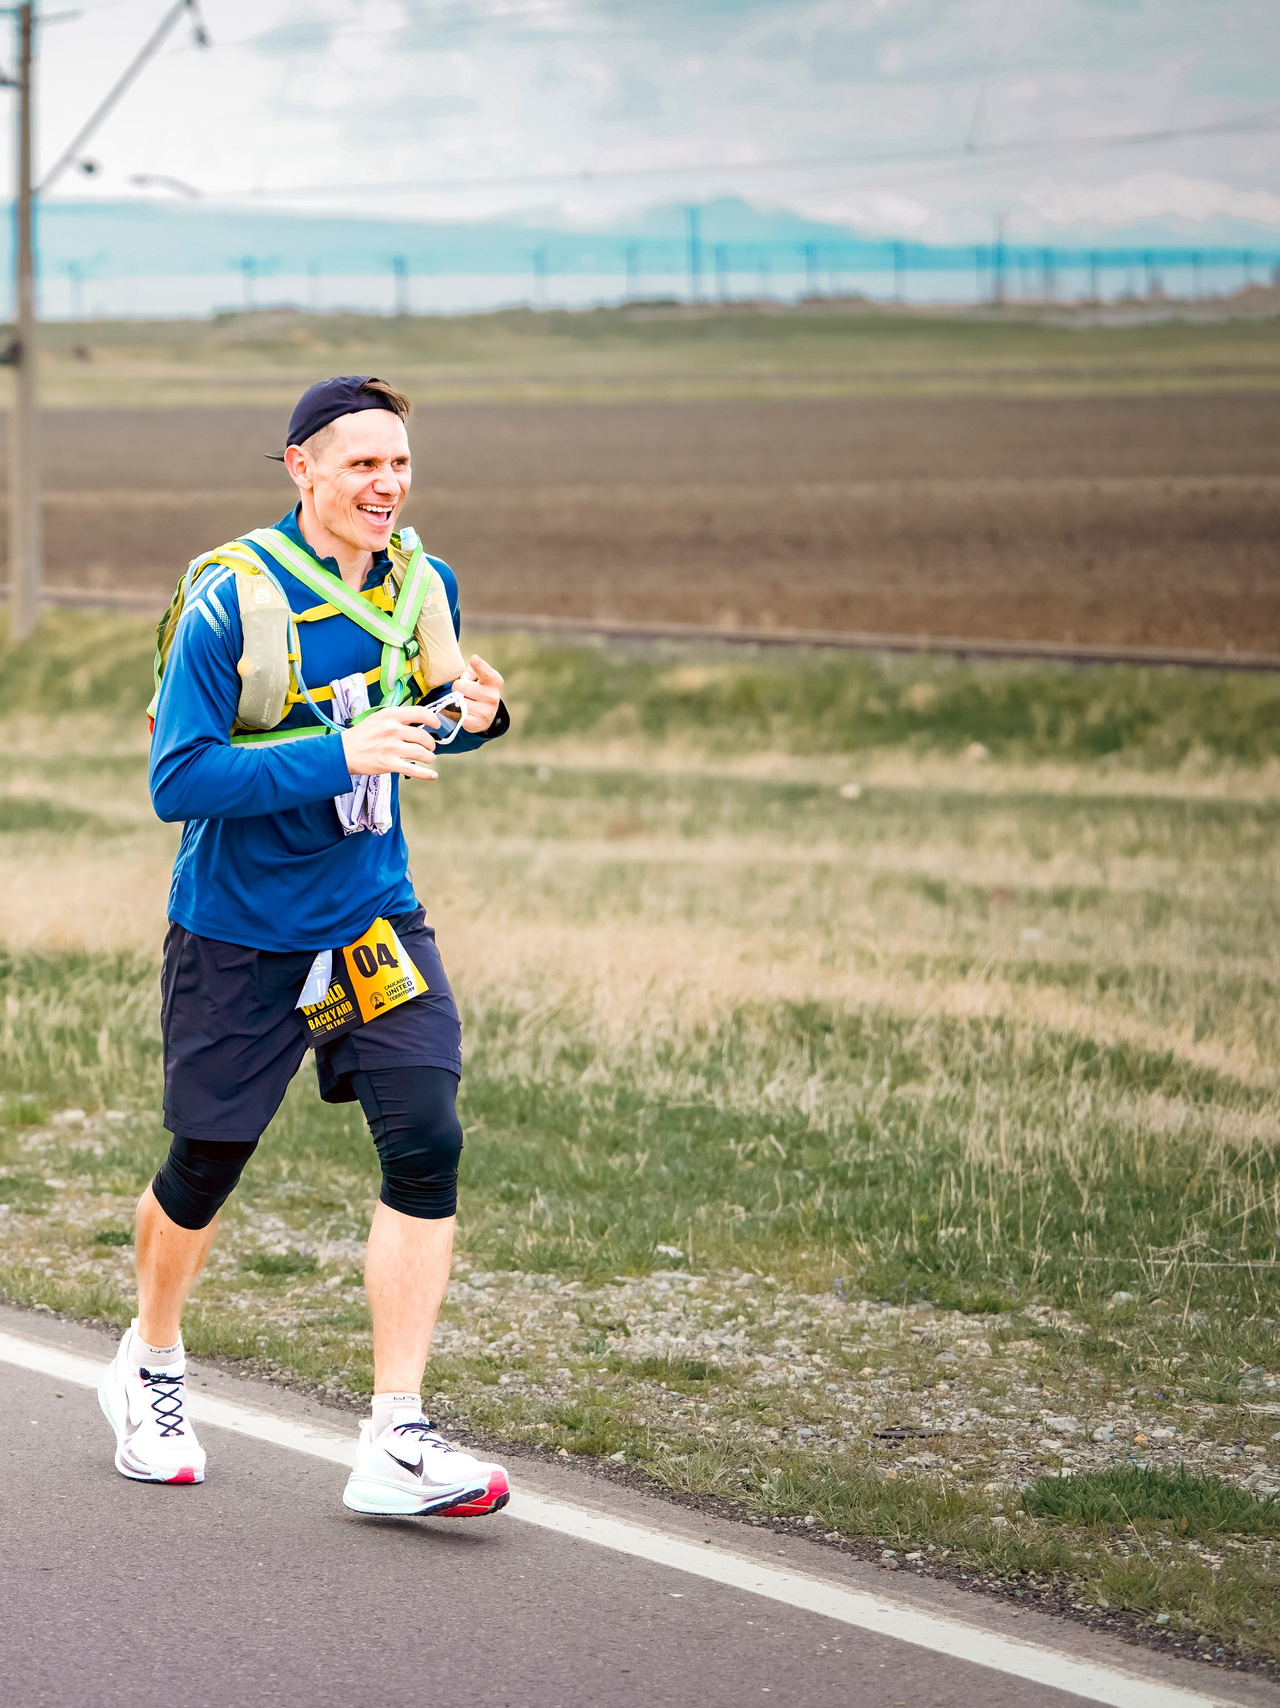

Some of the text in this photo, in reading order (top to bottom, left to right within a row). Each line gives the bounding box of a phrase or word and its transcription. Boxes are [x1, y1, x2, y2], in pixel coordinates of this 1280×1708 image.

[352, 943, 398, 978] 04
[384, 976, 410, 990] CAUCASUS
[386, 980, 413, 997] UNITED
[389, 987, 415, 1001] TERRITORY
[307, 1000, 353, 1030] BACKYARD
[326, 1018, 346, 1030] ULTRA
